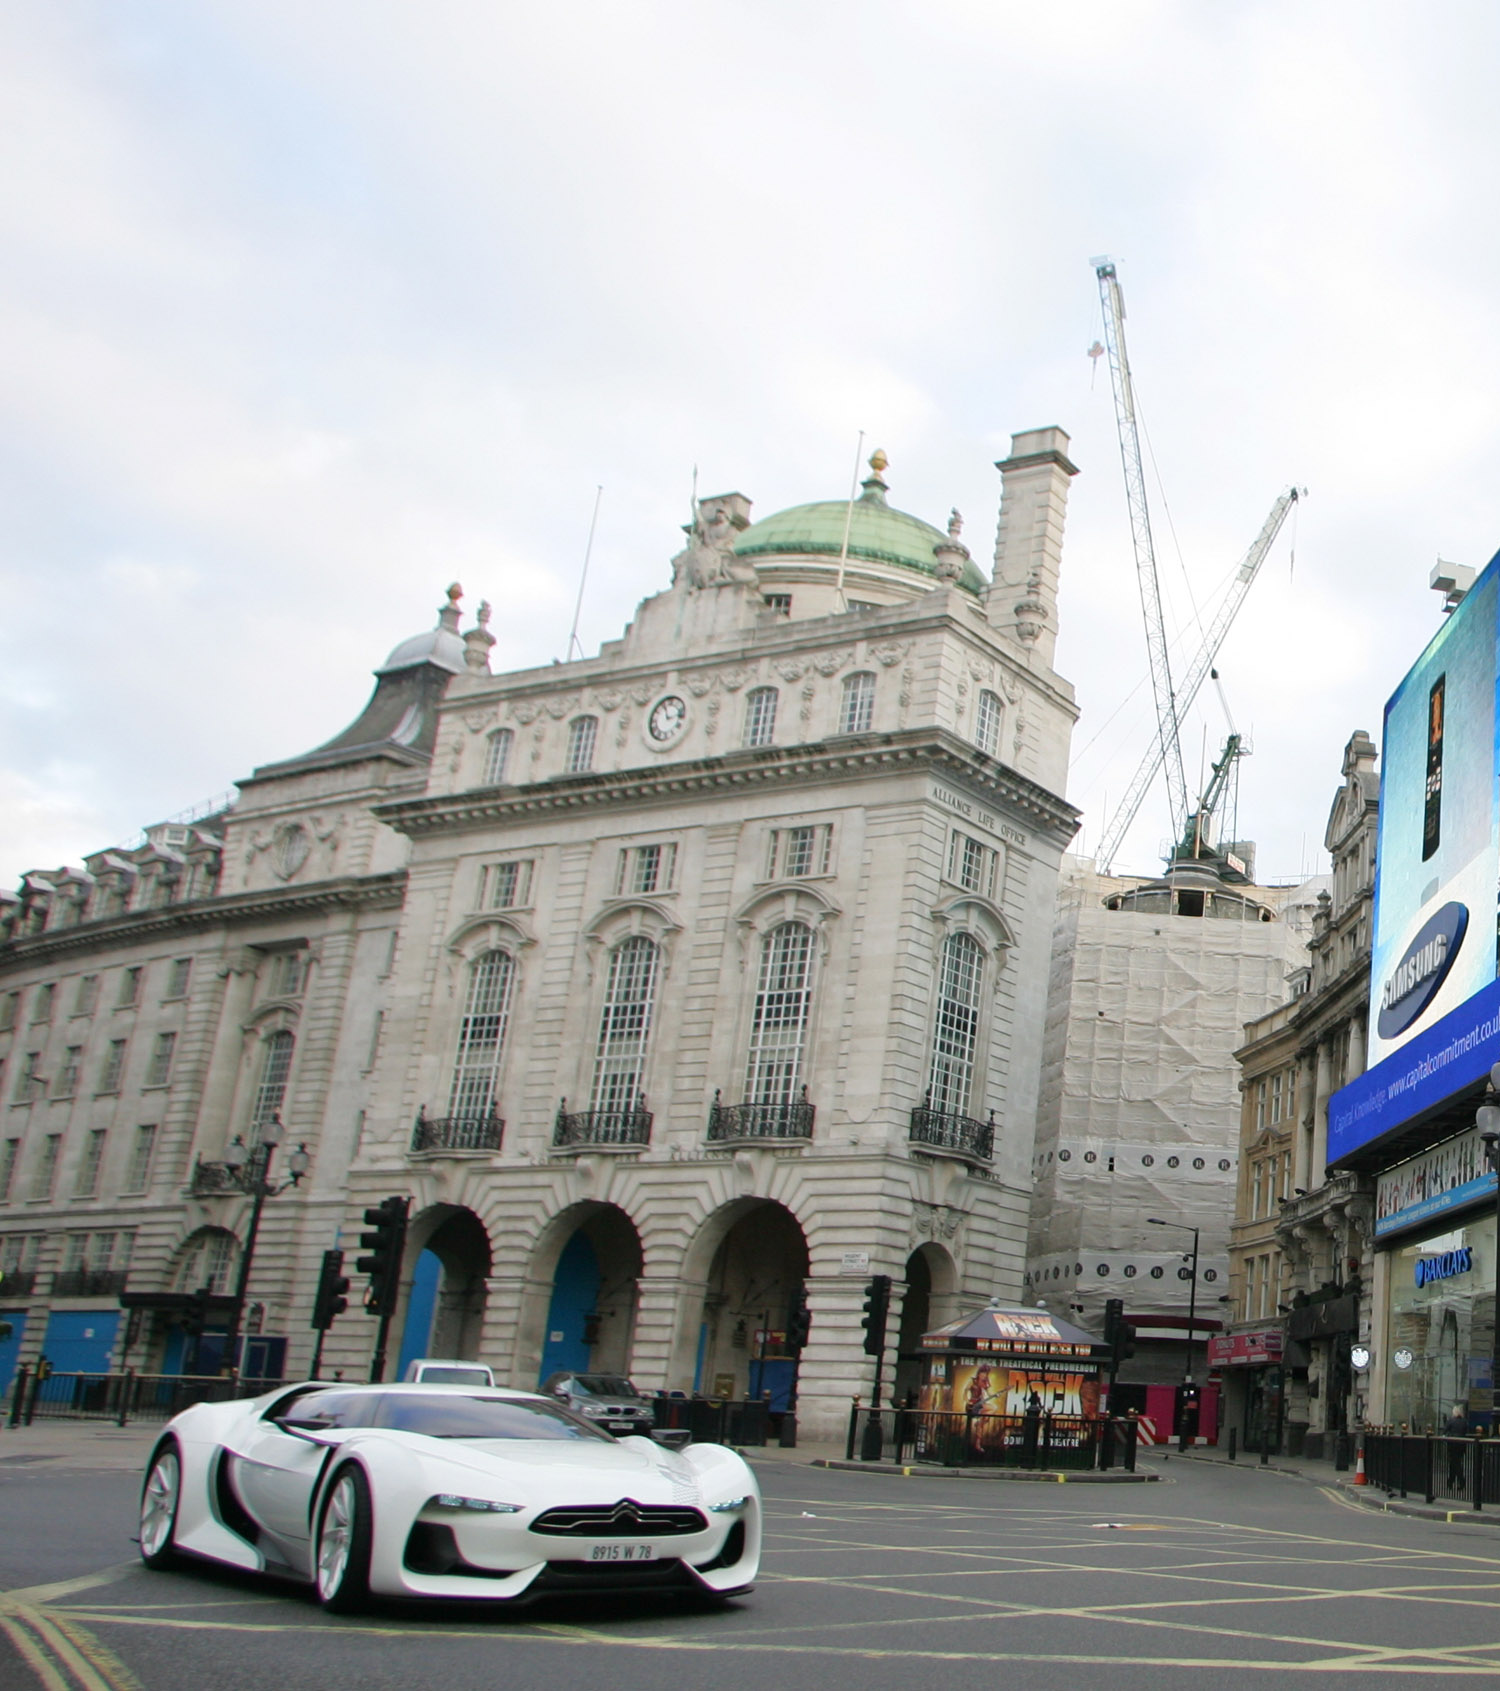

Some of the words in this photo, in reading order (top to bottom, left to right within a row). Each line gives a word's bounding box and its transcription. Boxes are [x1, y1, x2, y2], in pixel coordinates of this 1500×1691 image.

[933, 787, 972, 817] ALLIANCE
[978, 811, 995, 830] LIFE
[1001, 824, 1026, 847] OFFICE
[1383, 934, 1447, 1010] SAMSUNG
[1424, 1247, 1473, 1282] BARCLAYS
[960, 1356, 975, 1366] THE
[1000, 1359, 1043, 1371] THEATRICAL
[1044, 1361, 1098, 1374] PHENOMENON!
[991, 1340, 1012, 1352] WILL
[1028, 1342, 1048, 1355] WILL
[1004, 1370, 1085, 1417] ROCK
[592, 1545, 619, 1560] 8915
[624, 1546, 635, 1559] W
[639, 1545, 652, 1559] 78
